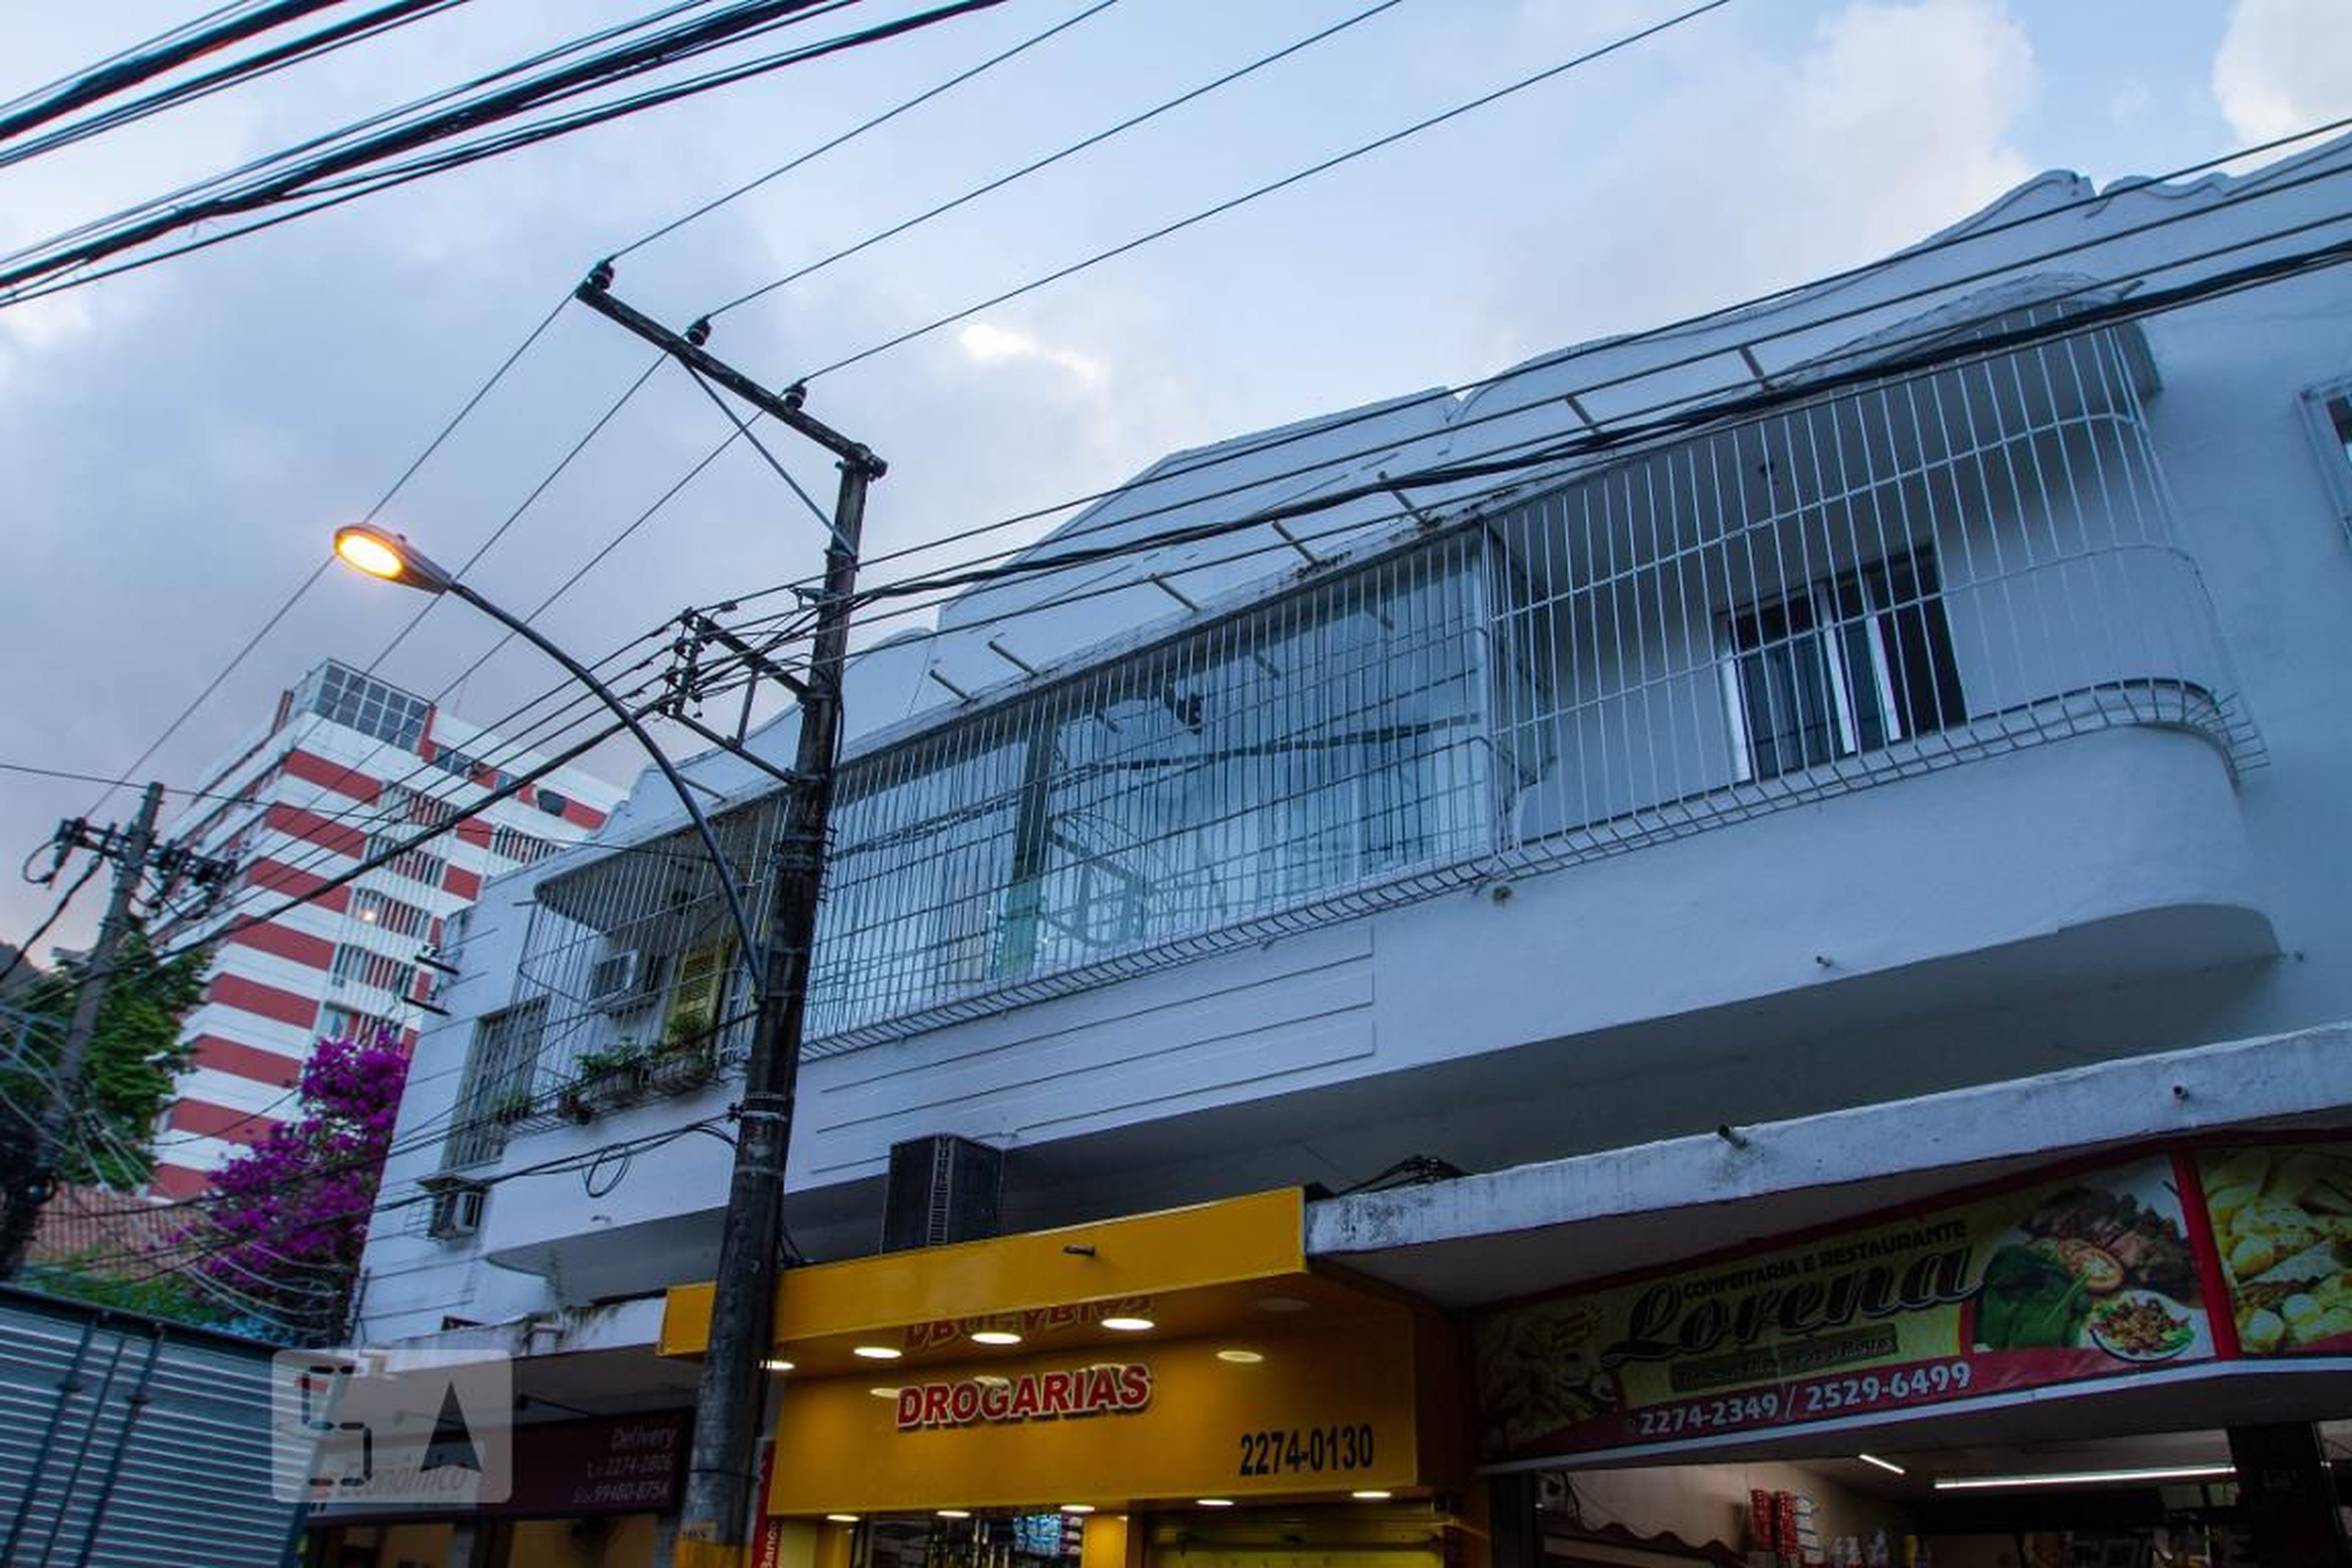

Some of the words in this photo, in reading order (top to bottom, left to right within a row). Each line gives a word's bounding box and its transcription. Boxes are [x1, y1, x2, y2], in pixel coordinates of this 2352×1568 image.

[1683, 1259, 1798, 1298] CONFEITARIA
[1804, 1255, 1815, 1272] E
[1820, 1220, 1967, 1267] RESTAURANTE
[1601, 1246, 1985, 1371] Lorena
[897, 1363, 1152, 1428] DROGARIAS
[1640, 1392, 1779, 1436] 2274-2349
[1805, 1360, 1972, 1412] 2529-6499
[611, 1425, 677, 1452] Delivery
[1240, 1424, 1374, 1476] 2274-0130
